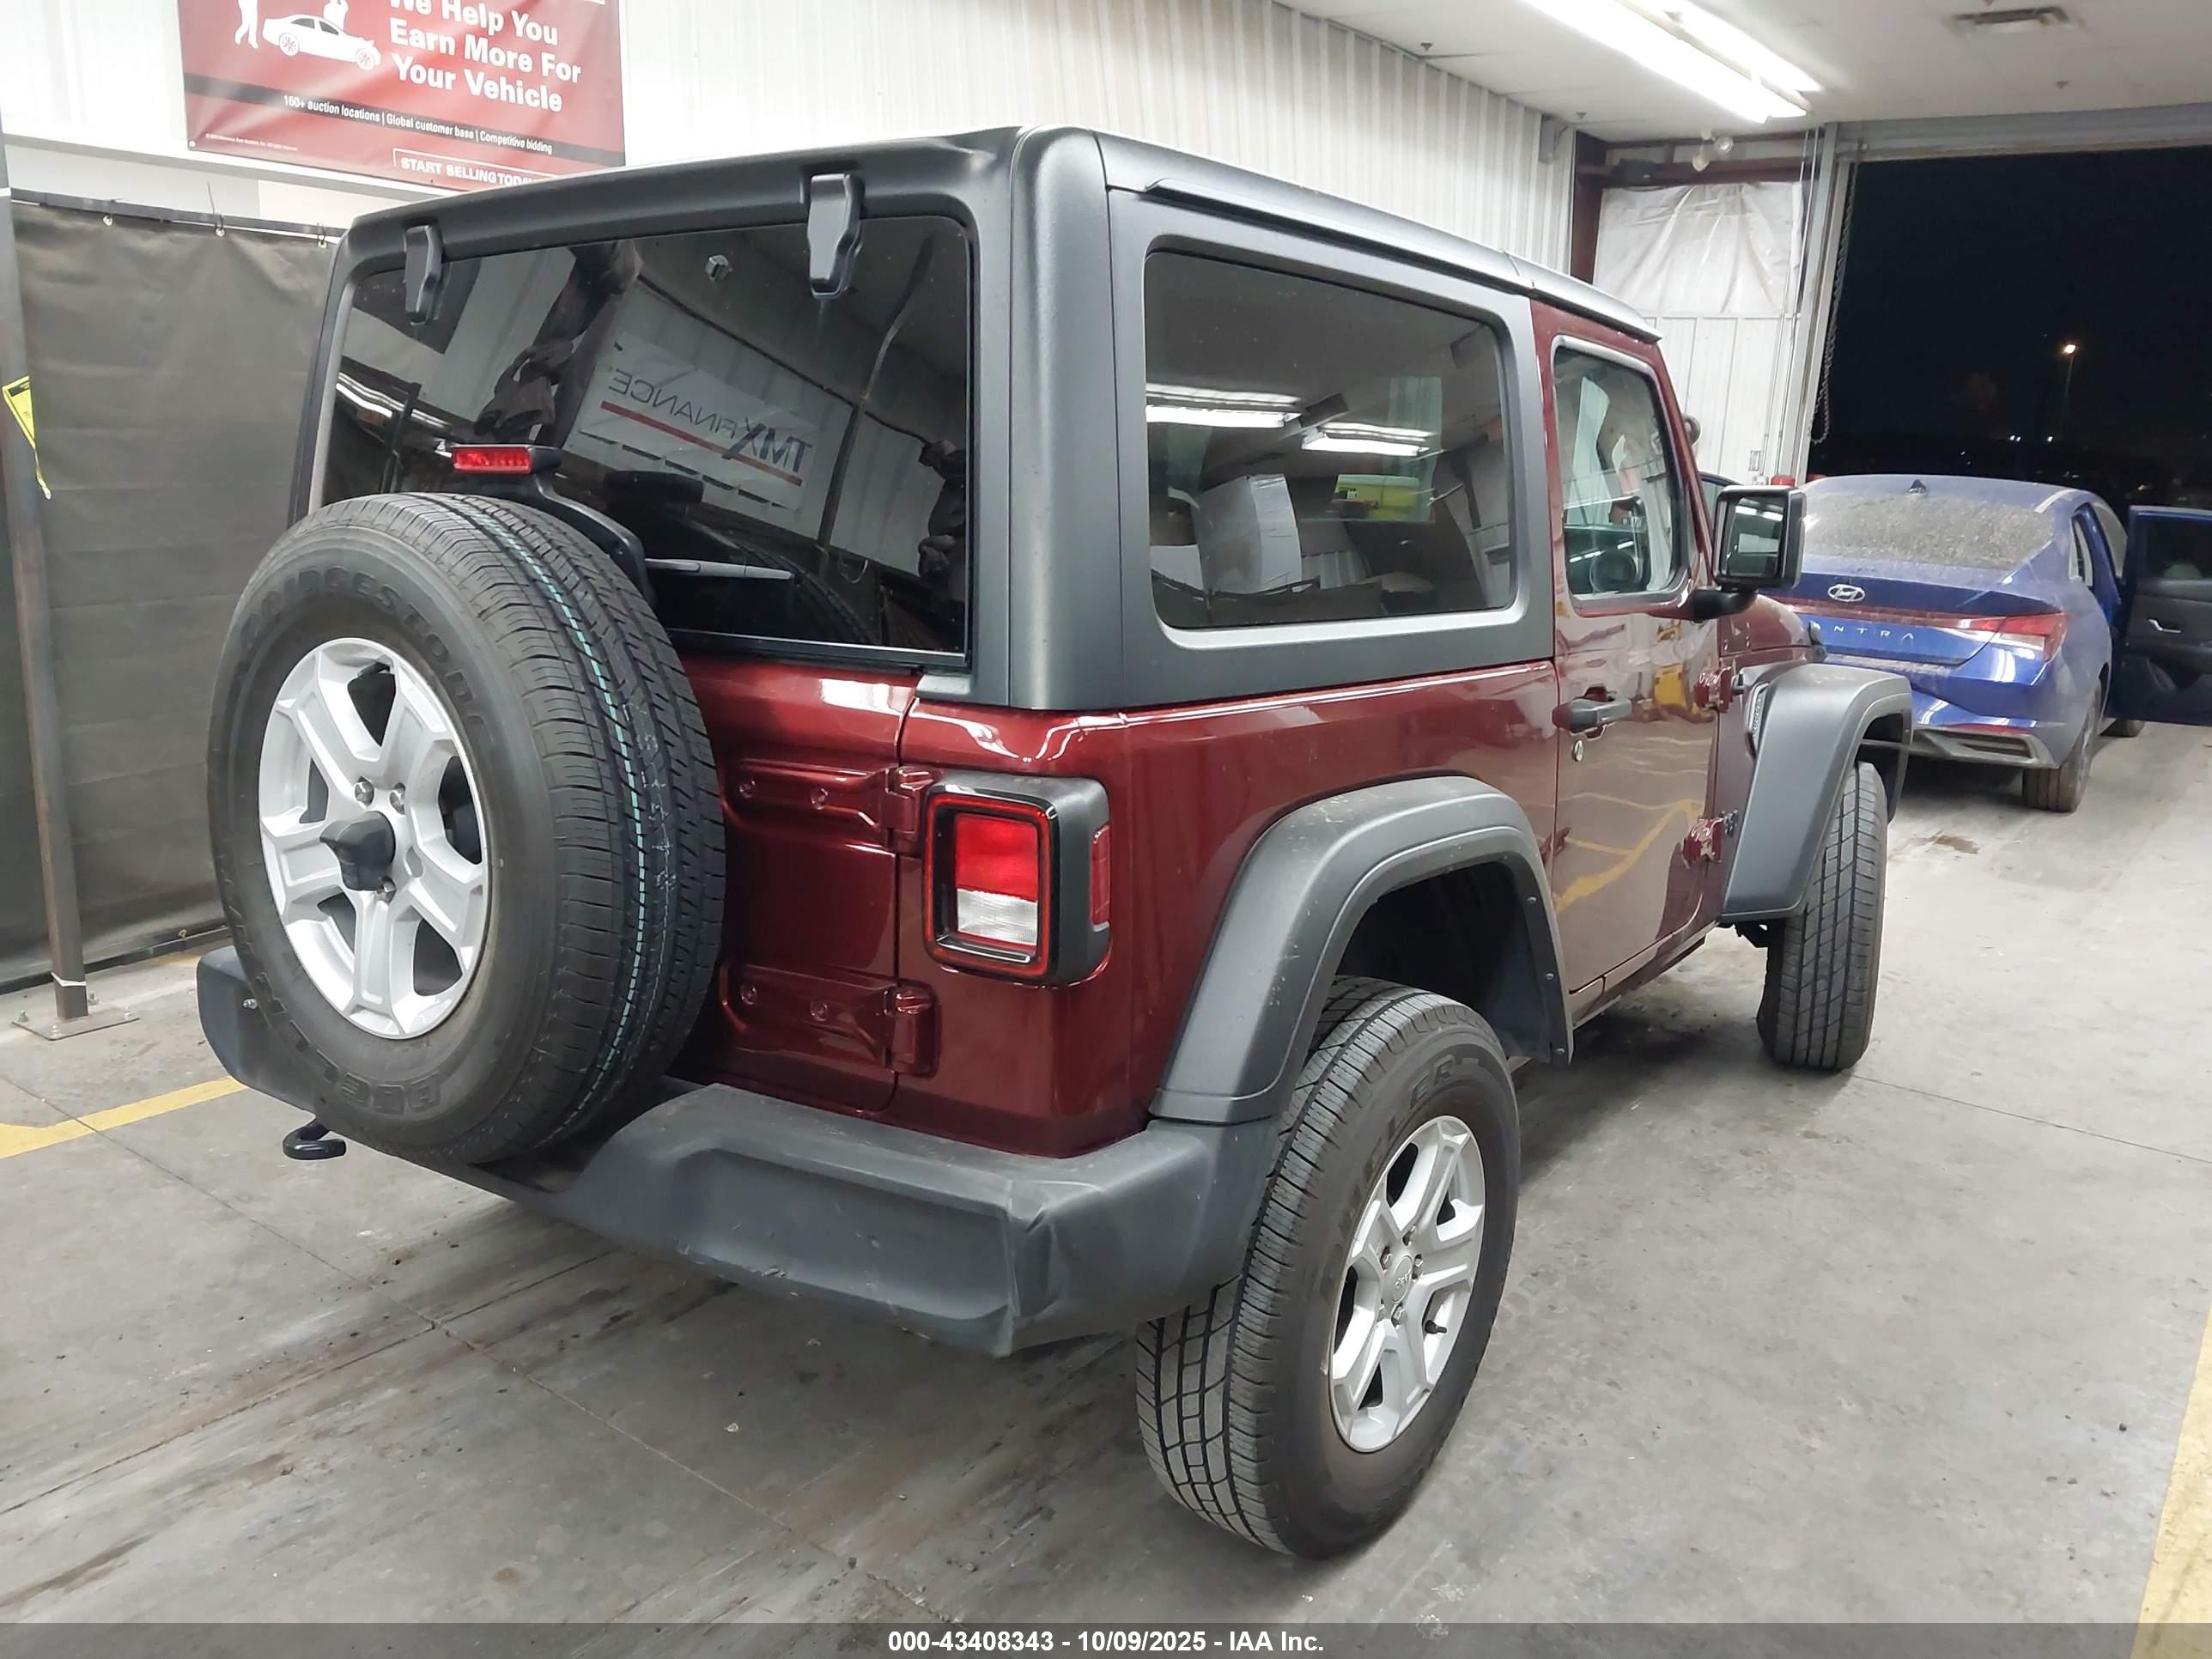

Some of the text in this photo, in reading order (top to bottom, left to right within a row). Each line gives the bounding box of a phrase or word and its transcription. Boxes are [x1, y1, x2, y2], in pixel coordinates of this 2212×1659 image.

[389, 16, 581, 83] Earn More For
[441, 0, 505, 36] Help
[511, 9, 558, 46] You
[392, 52, 563, 112] Your Vehicle
[283, 94, 305, 108] 160+
[307, 100, 340, 115] auction
[341, 104, 380, 123] locations
[386, 112, 414, 128] Global
[415, 119, 453, 136] customer
[454, 125, 474, 139] base
[479, 130, 526, 149] Competitive
[526, 138, 553, 155] bidding
[400, 157, 442, 175] START
[445, 164, 497, 183] SELLING
